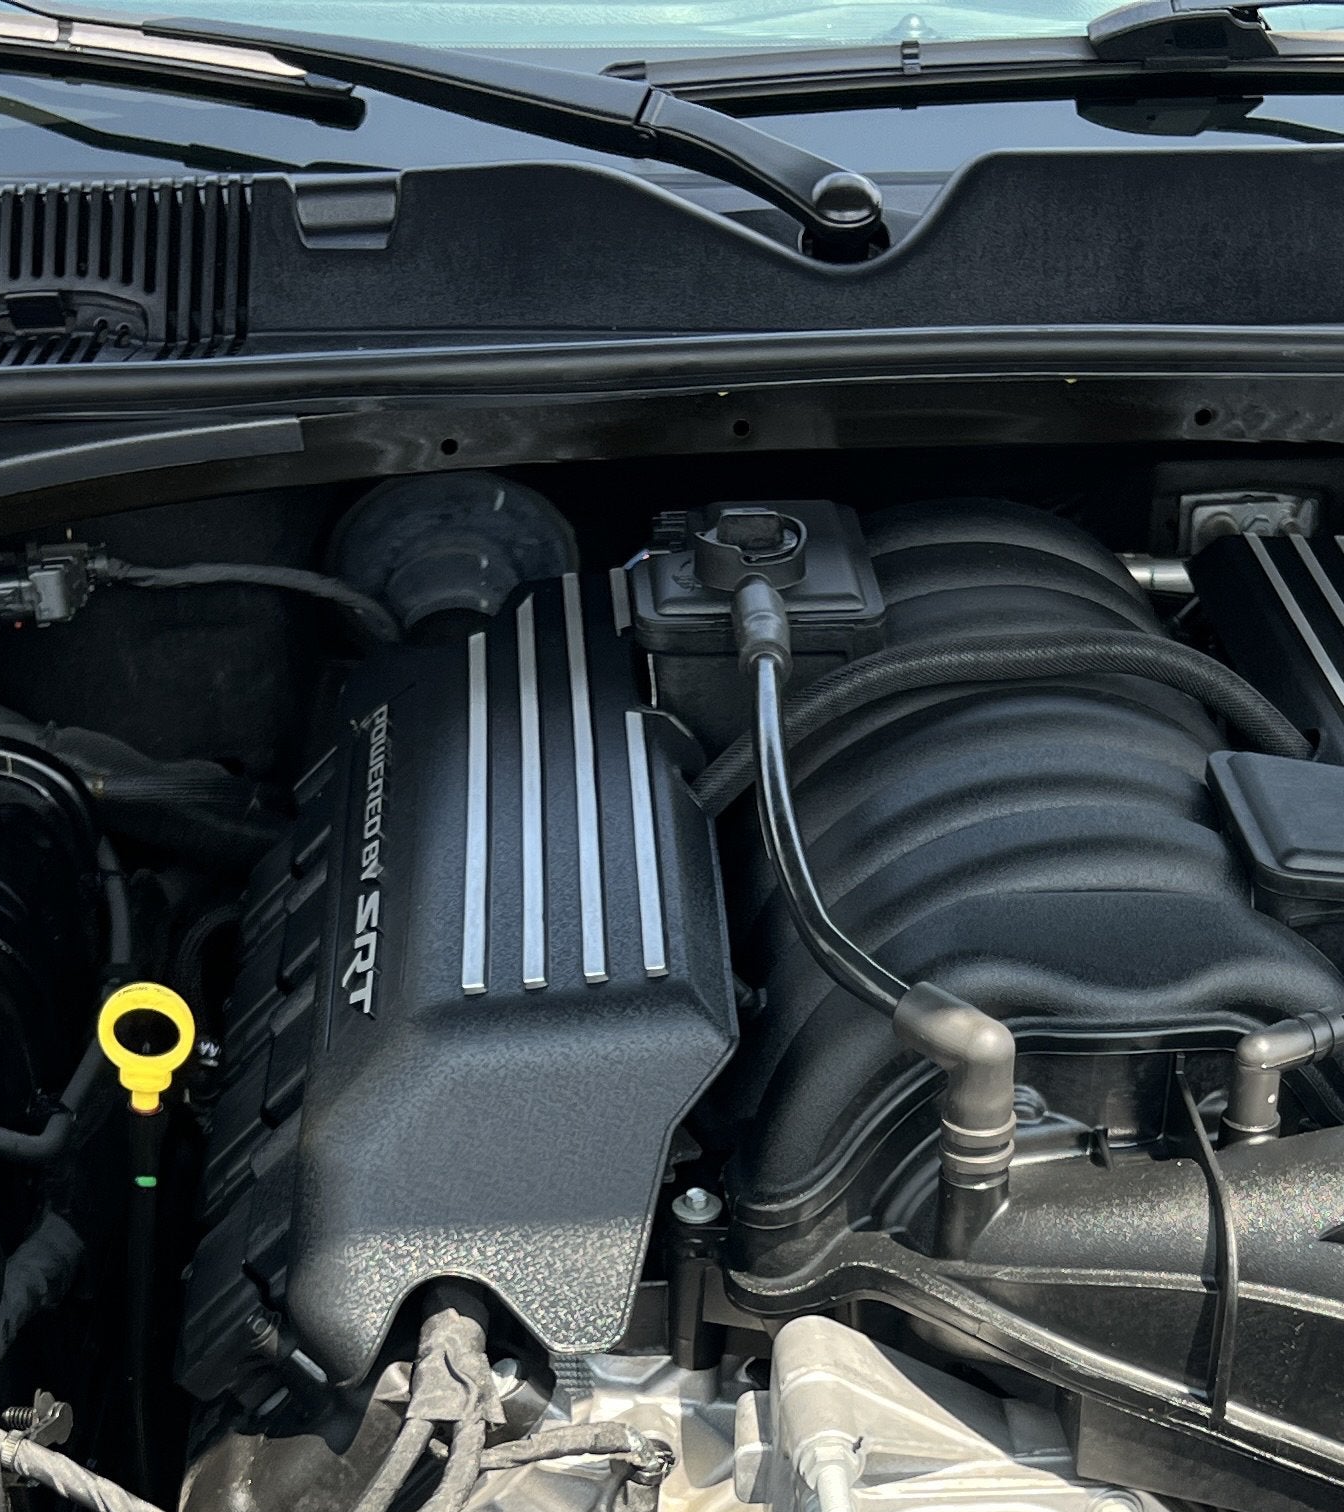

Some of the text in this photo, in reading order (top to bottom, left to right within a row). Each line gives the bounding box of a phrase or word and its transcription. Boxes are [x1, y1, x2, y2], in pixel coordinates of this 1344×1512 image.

[341, 703, 389, 1014] POWERED BY SRT
